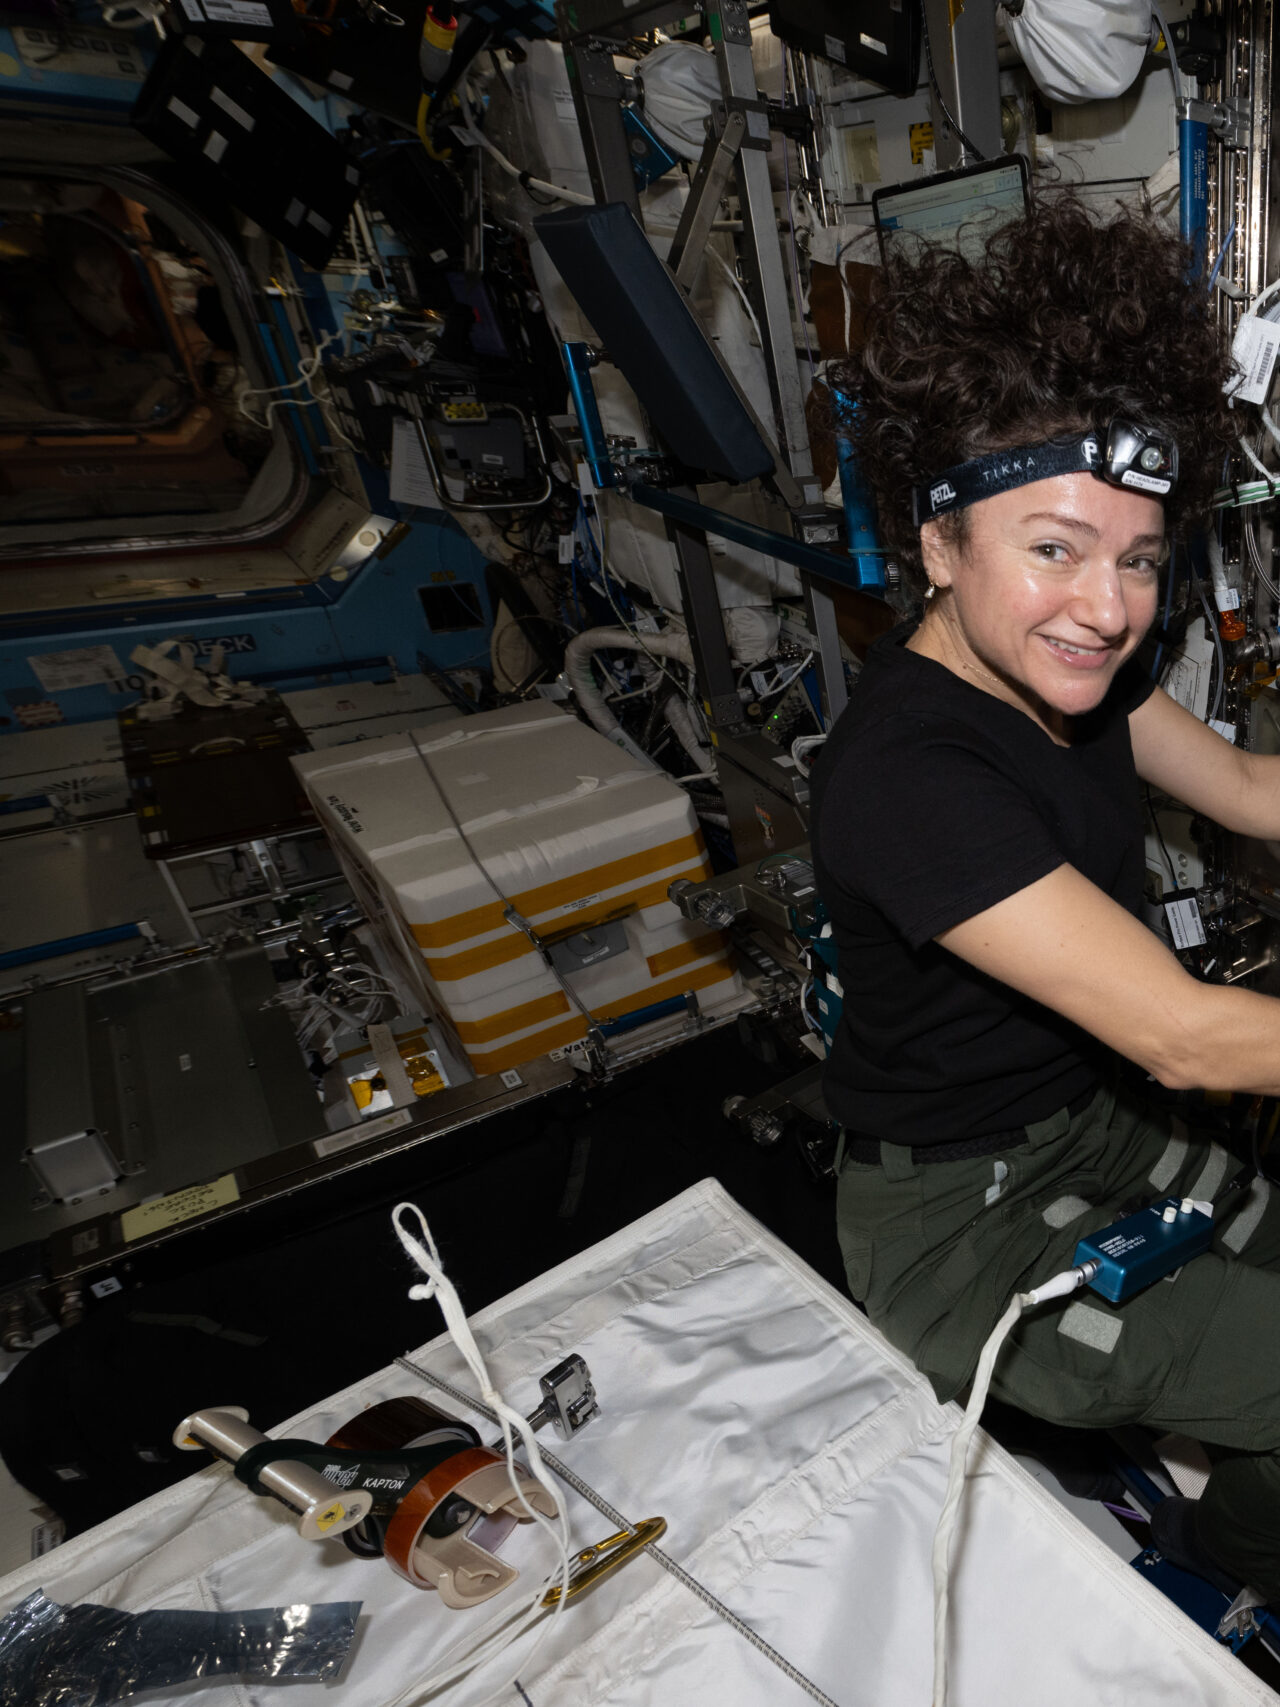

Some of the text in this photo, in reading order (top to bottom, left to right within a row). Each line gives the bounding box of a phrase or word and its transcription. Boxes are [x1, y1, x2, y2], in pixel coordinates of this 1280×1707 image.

[983, 456, 1036, 481] TIKKA
[930, 482, 957, 512] PETZL
[362, 1477, 405, 1490] KAPTON
